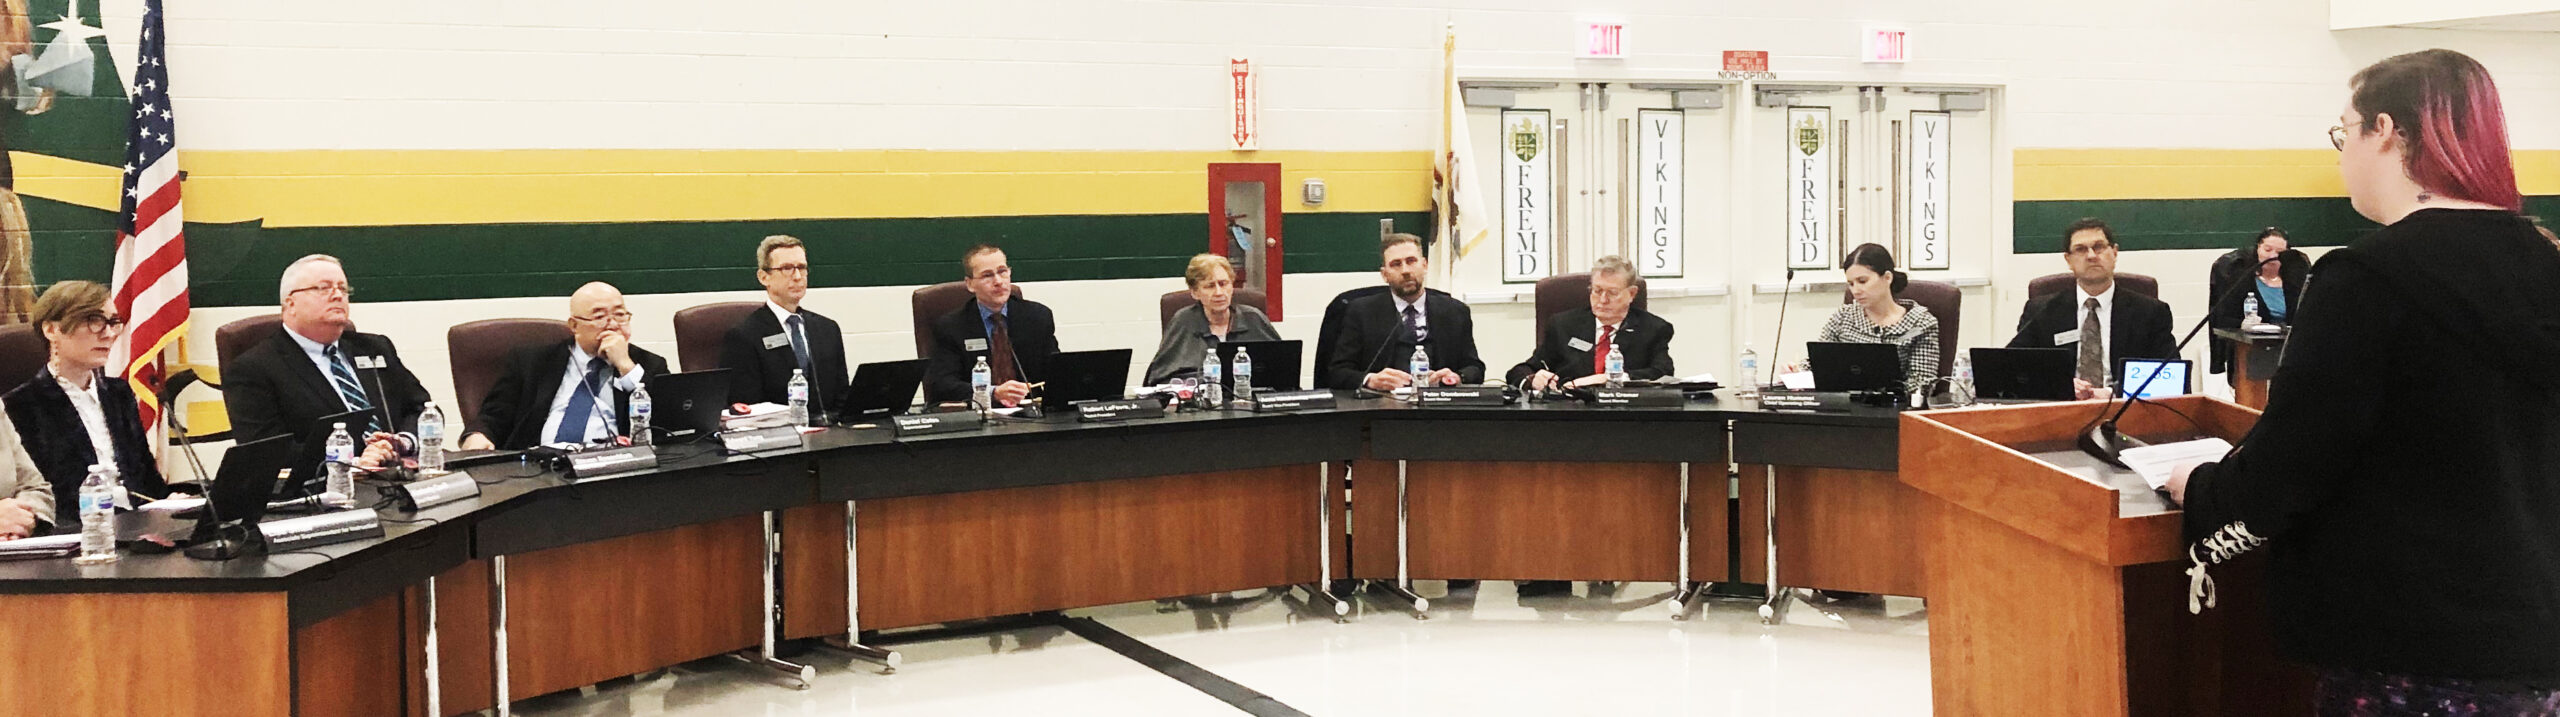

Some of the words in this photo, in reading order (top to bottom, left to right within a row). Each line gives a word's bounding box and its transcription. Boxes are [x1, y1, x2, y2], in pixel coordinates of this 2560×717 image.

[1232, 63, 1248, 73] FIRE
[1590, 25, 1622, 55] EXIT
[1876, 31, 1905, 60] EXIT
[1718, 71, 1776, 80] NON-OPTION
[1237, 76, 1245, 143] EXTINGUISHER
[1517, 165, 1537, 275] FREMD
[1654, 120, 1668, 269] VIKINGS
[1800, 159, 1818, 262] FREMD
[1923, 121, 1936, 261] VIKINGS
